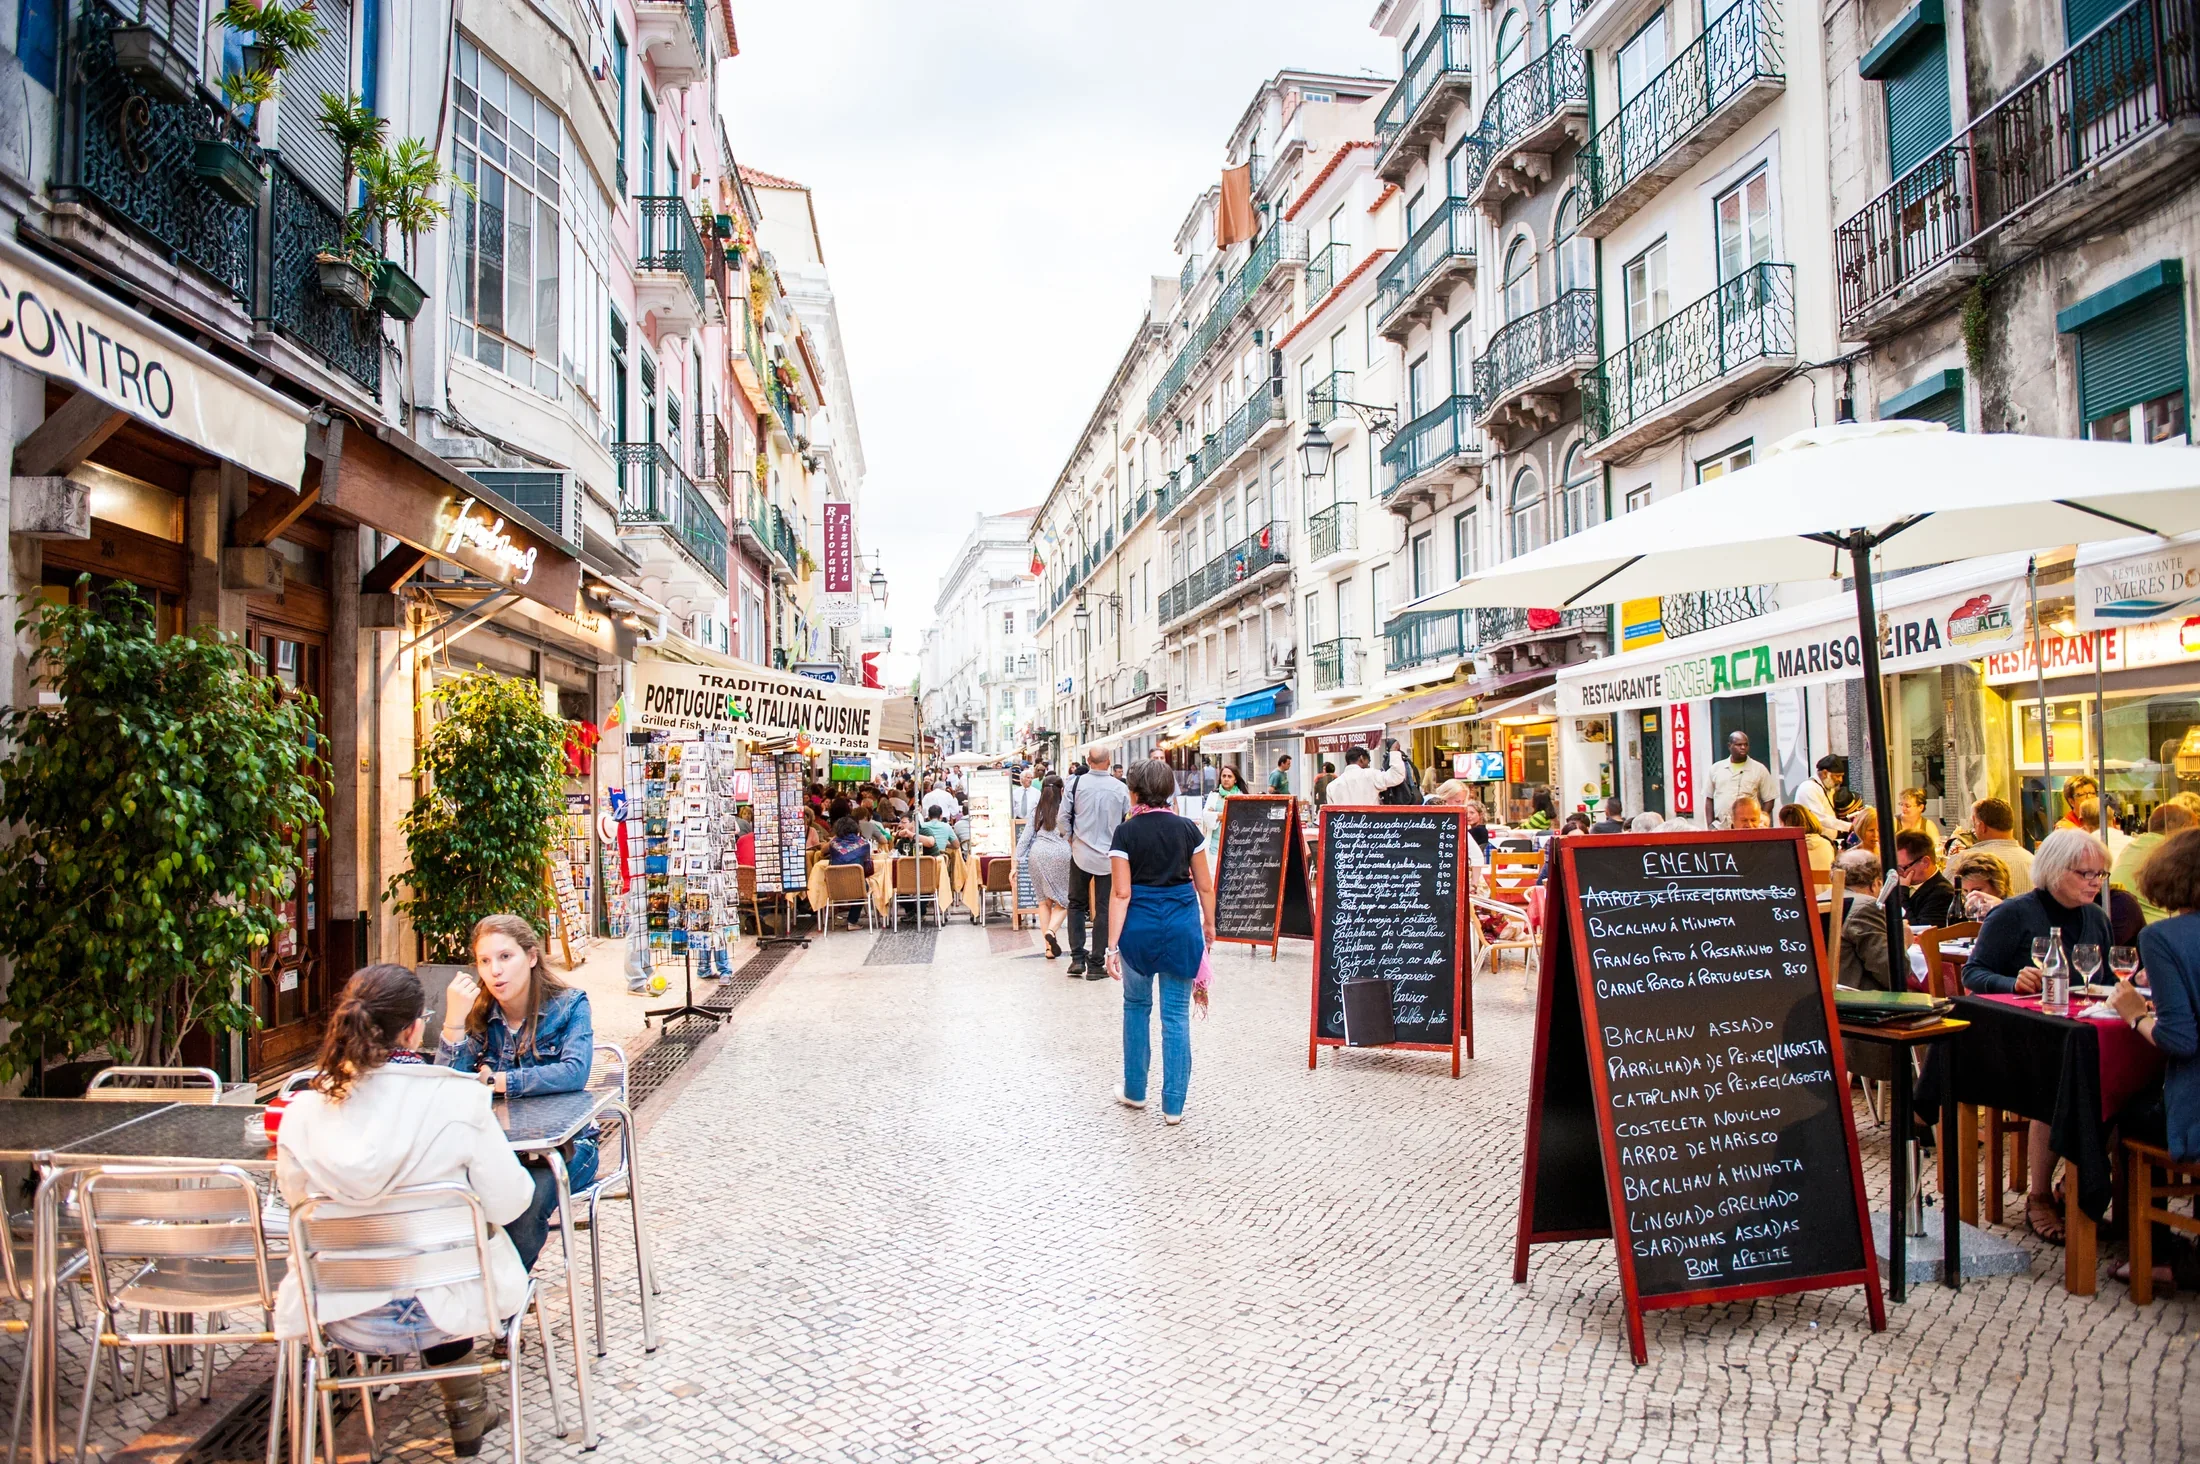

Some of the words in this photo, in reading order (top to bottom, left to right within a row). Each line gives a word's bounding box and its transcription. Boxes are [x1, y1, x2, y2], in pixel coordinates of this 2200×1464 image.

[826, 507, 836, 590] Ristorante
[839, 515, 849, 581] Pizzaria
[2112, 557, 2183, 581] RESTAURANTE
[2095, 576, 2164, 604] PRAZERES
[1950, 614, 2012, 637] INHACA
[1582, 674, 1662, 706] RESTAURANTE
[1665, 645, 1775, 700] INHACA
[1777, 617, 1942, 679] MARISQEIRA
[699, 674, 826, 701] TRADITIONAL
[744, 697, 752, 723] &
[756, 700, 810, 731] ITALIAN
[814, 705, 871, 736] CUISINE
[641, 714, 676, 728] Grilled
[680, 719, 702, 730] Fish
[840, 737, 868, 749] Pasta
[1318, 736, 1338, 744] TABERNA
[1340, 735, 1346, 743] DO
[1349, 733, 1366, 742] ROSSIO
[1642, 852, 1738, 875] EMENTA
[1589, 917, 1666, 938] BACALHAU
[1593, 949, 1649, 969] FRANGO
[1597, 979, 1645, 999] CARNE
[1698, 968, 1772, 985] PORTUGUESA
[1709, 1017, 1774, 1038] ASSADO
[1707, 1053, 1723, 1073] DE
[1612, 1087, 1700, 1108] CATAPLANA
[1704, 1083, 1723, 1102] DE
[1616, 1116, 1707, 1138] COSTELETA
[1623, 1146, 1679, 1167] ARROZ
[1686, 1142, 1706, 1159] DE
[1718, 1190, 1799, 1217] GRELHADO
[1735, 1219, 1800, 1242] ASSADAS
[1684, 1258, 1719, 1277] BOM
